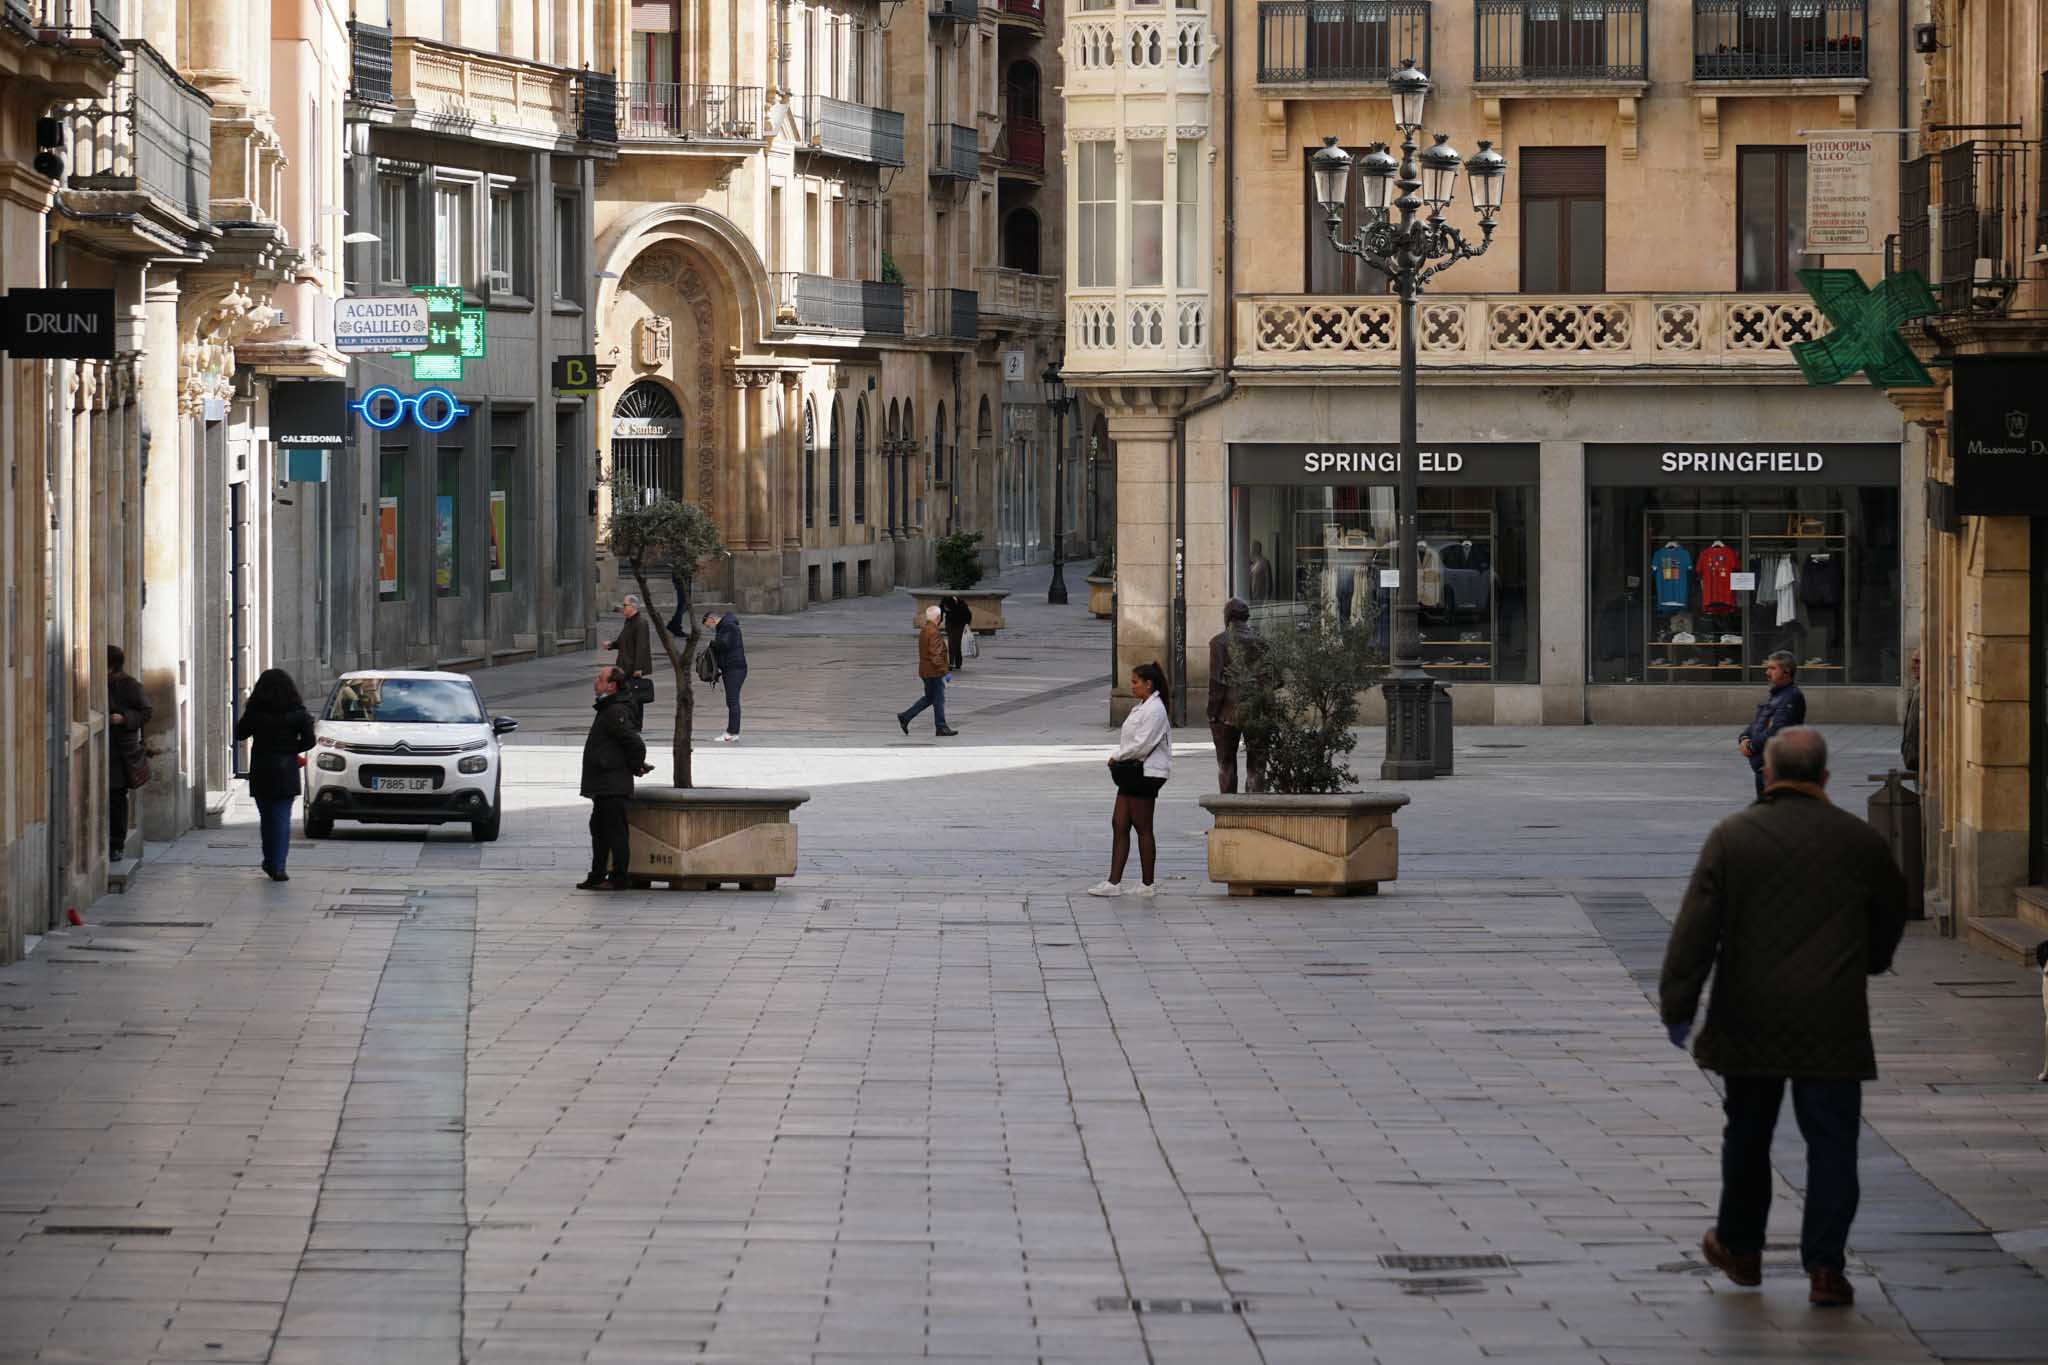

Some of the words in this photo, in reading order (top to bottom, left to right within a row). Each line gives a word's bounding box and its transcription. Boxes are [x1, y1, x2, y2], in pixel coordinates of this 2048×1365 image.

[1809, 141, 1872, 153] FOTOCOPIAS
[346, 303, 418, 317] ACADEMIA
[25, 312, 98, 334] DRUNI
[353, 320, 411, 334] GALILEO
[567, 360, 588, 385] B
[631, 423, 671, 435] Santan
[280, 435, 342, 443] CALZEDONIA
[1968, 440, 2026, 455] Massimo
[1304, 452, 1463, 472] SPRINGELD
[1661, 452, 1823, 472] SPRINGFIELD
[380, 779, 405, 789] 7885
